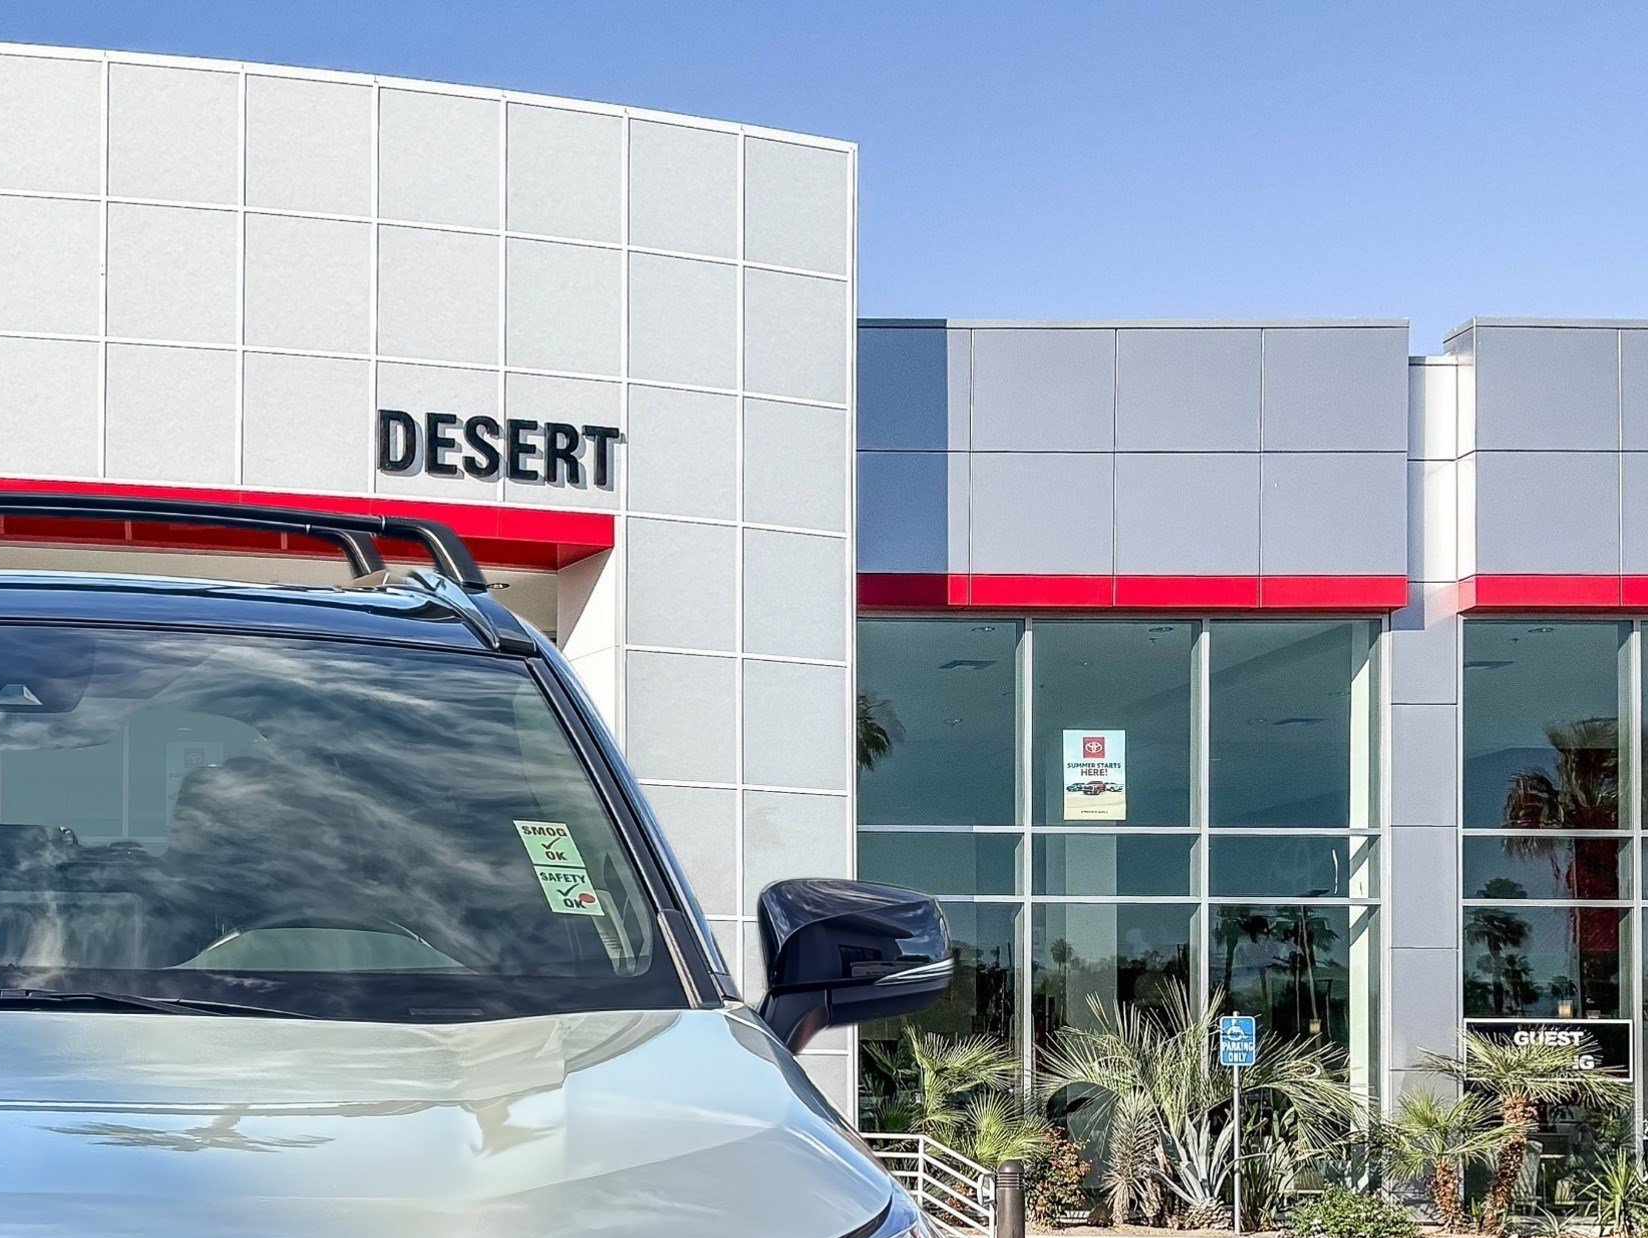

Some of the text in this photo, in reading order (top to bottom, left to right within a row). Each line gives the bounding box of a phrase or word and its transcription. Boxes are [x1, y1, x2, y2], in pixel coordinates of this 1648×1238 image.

[377, 409, 620, 486] DESERT
[521, 825, 568, 837] SMOG
[545, 850, 568, 861] OK
[539, 871, 586, 884] SAFETY
[563, 898, 587, 909] OK
[1513, 1031, 1585, 1047] GUEST
[1222, 1041, 1253, 1052] PARKING
[1228, 1052, 1247, 1062] ONLY
